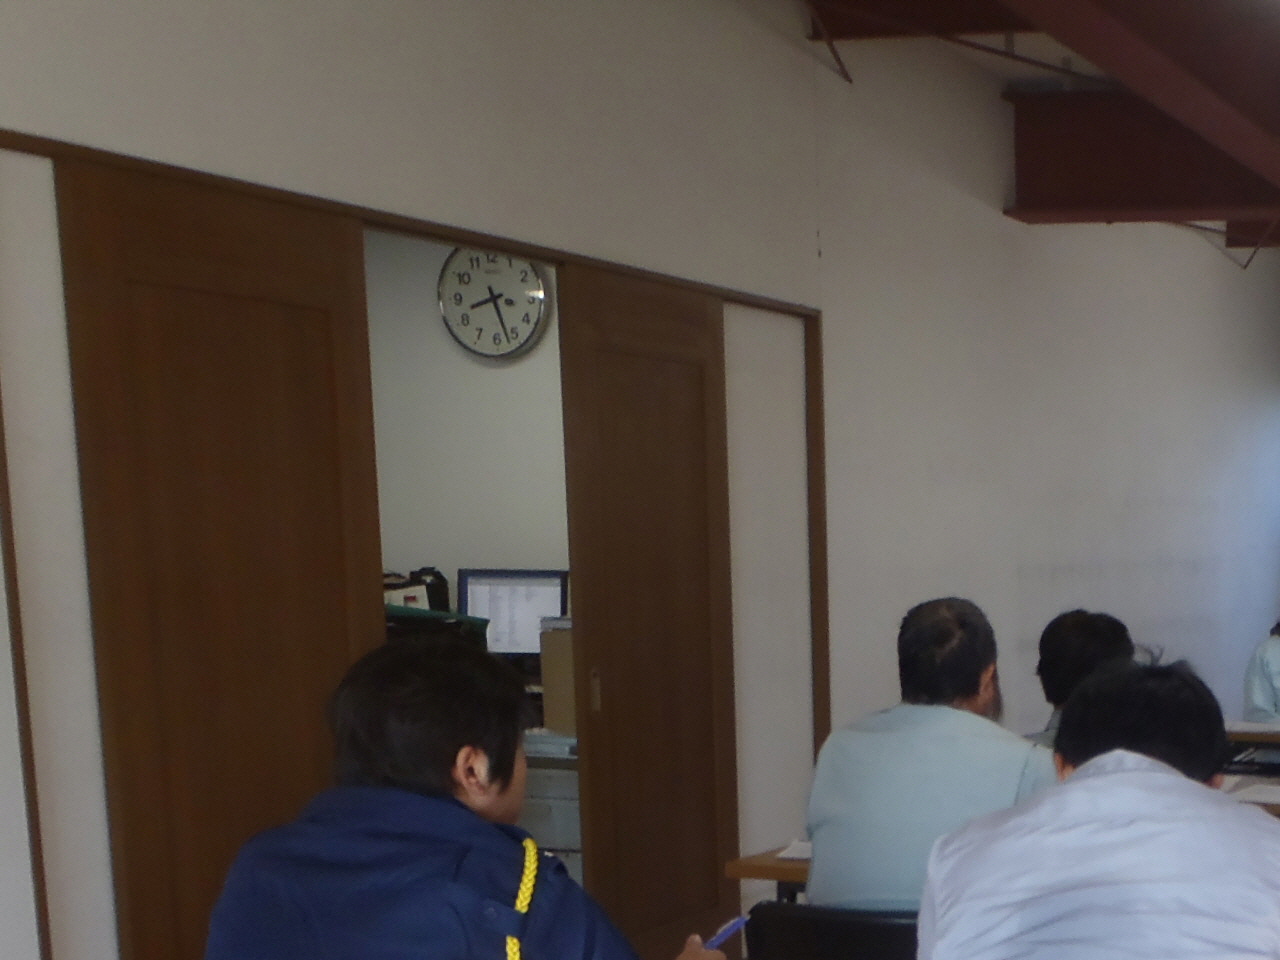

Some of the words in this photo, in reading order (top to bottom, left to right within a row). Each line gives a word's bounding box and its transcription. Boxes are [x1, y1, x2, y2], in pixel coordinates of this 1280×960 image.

[457, 271, 471, 285] 10
[520, 270, 528, 283] 2
[454, 292, 463, 306] 9
[461, 313, 470, 326] 8
[522, 313, 531, 325] 4
[475, 328, 483, 340] 7
[493, 333, 502, 346] 6
[510, 327, 519, 340] 5
